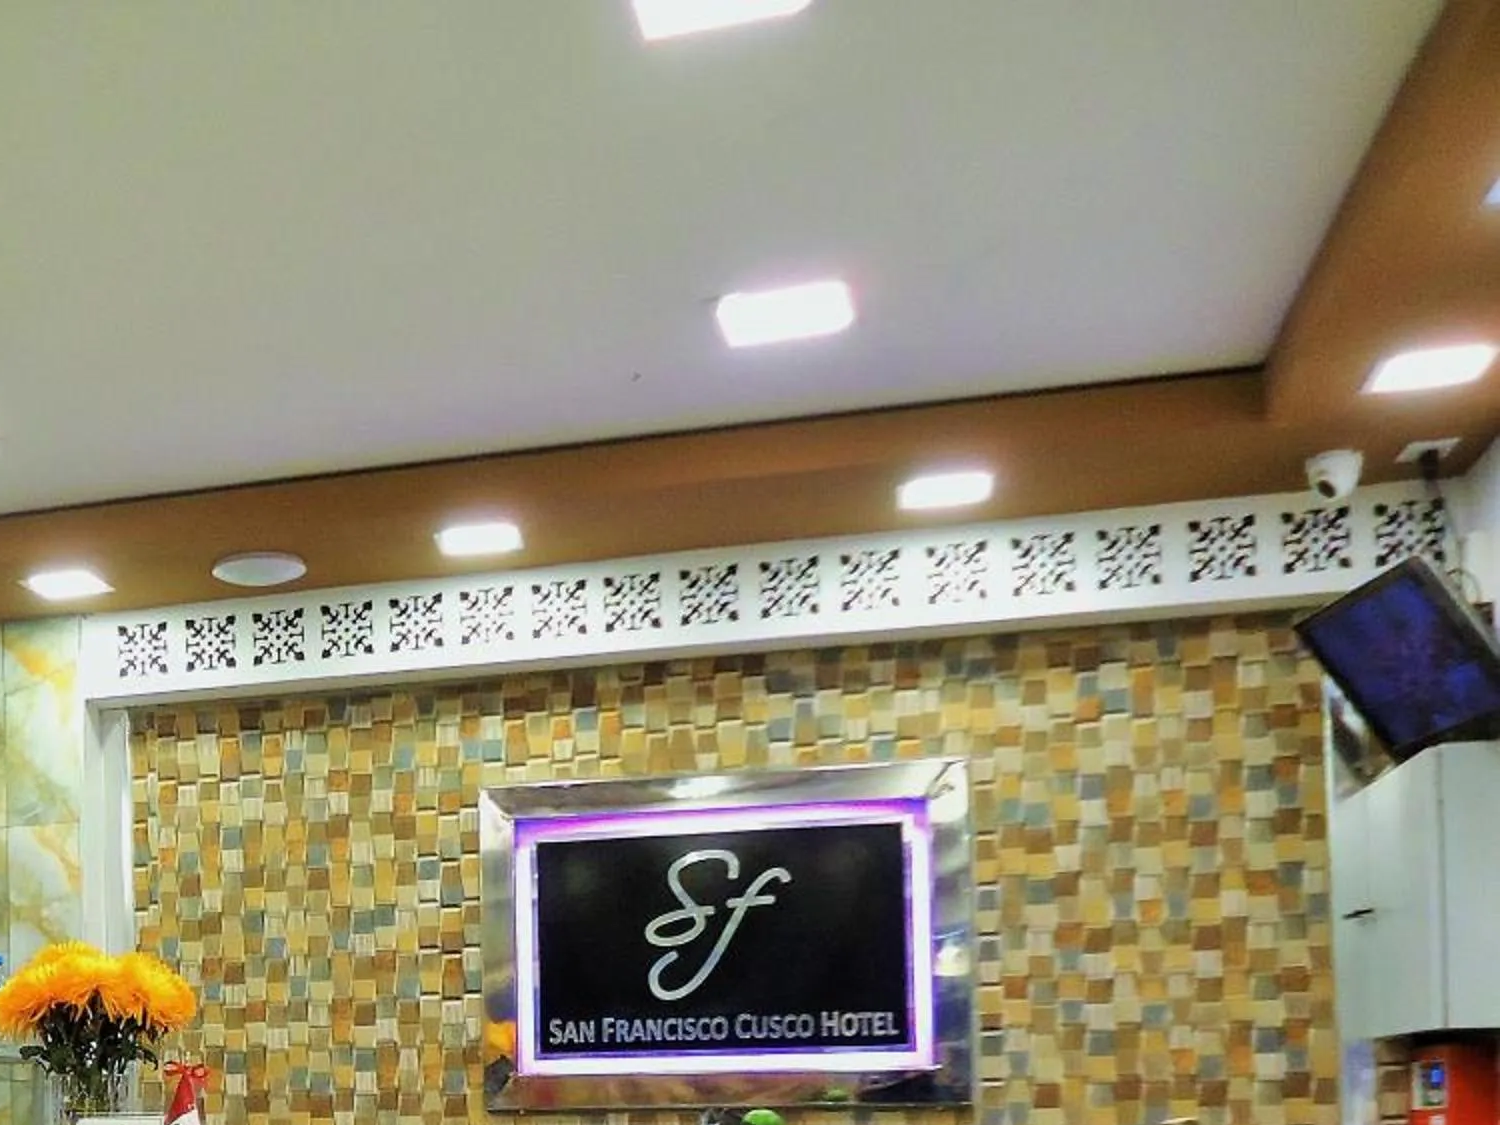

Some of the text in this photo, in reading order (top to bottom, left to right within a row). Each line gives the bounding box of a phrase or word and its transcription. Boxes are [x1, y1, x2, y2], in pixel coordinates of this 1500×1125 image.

[549, 1010, 901, 1045] SAN FRANCISCO CUSCO HOTEL
